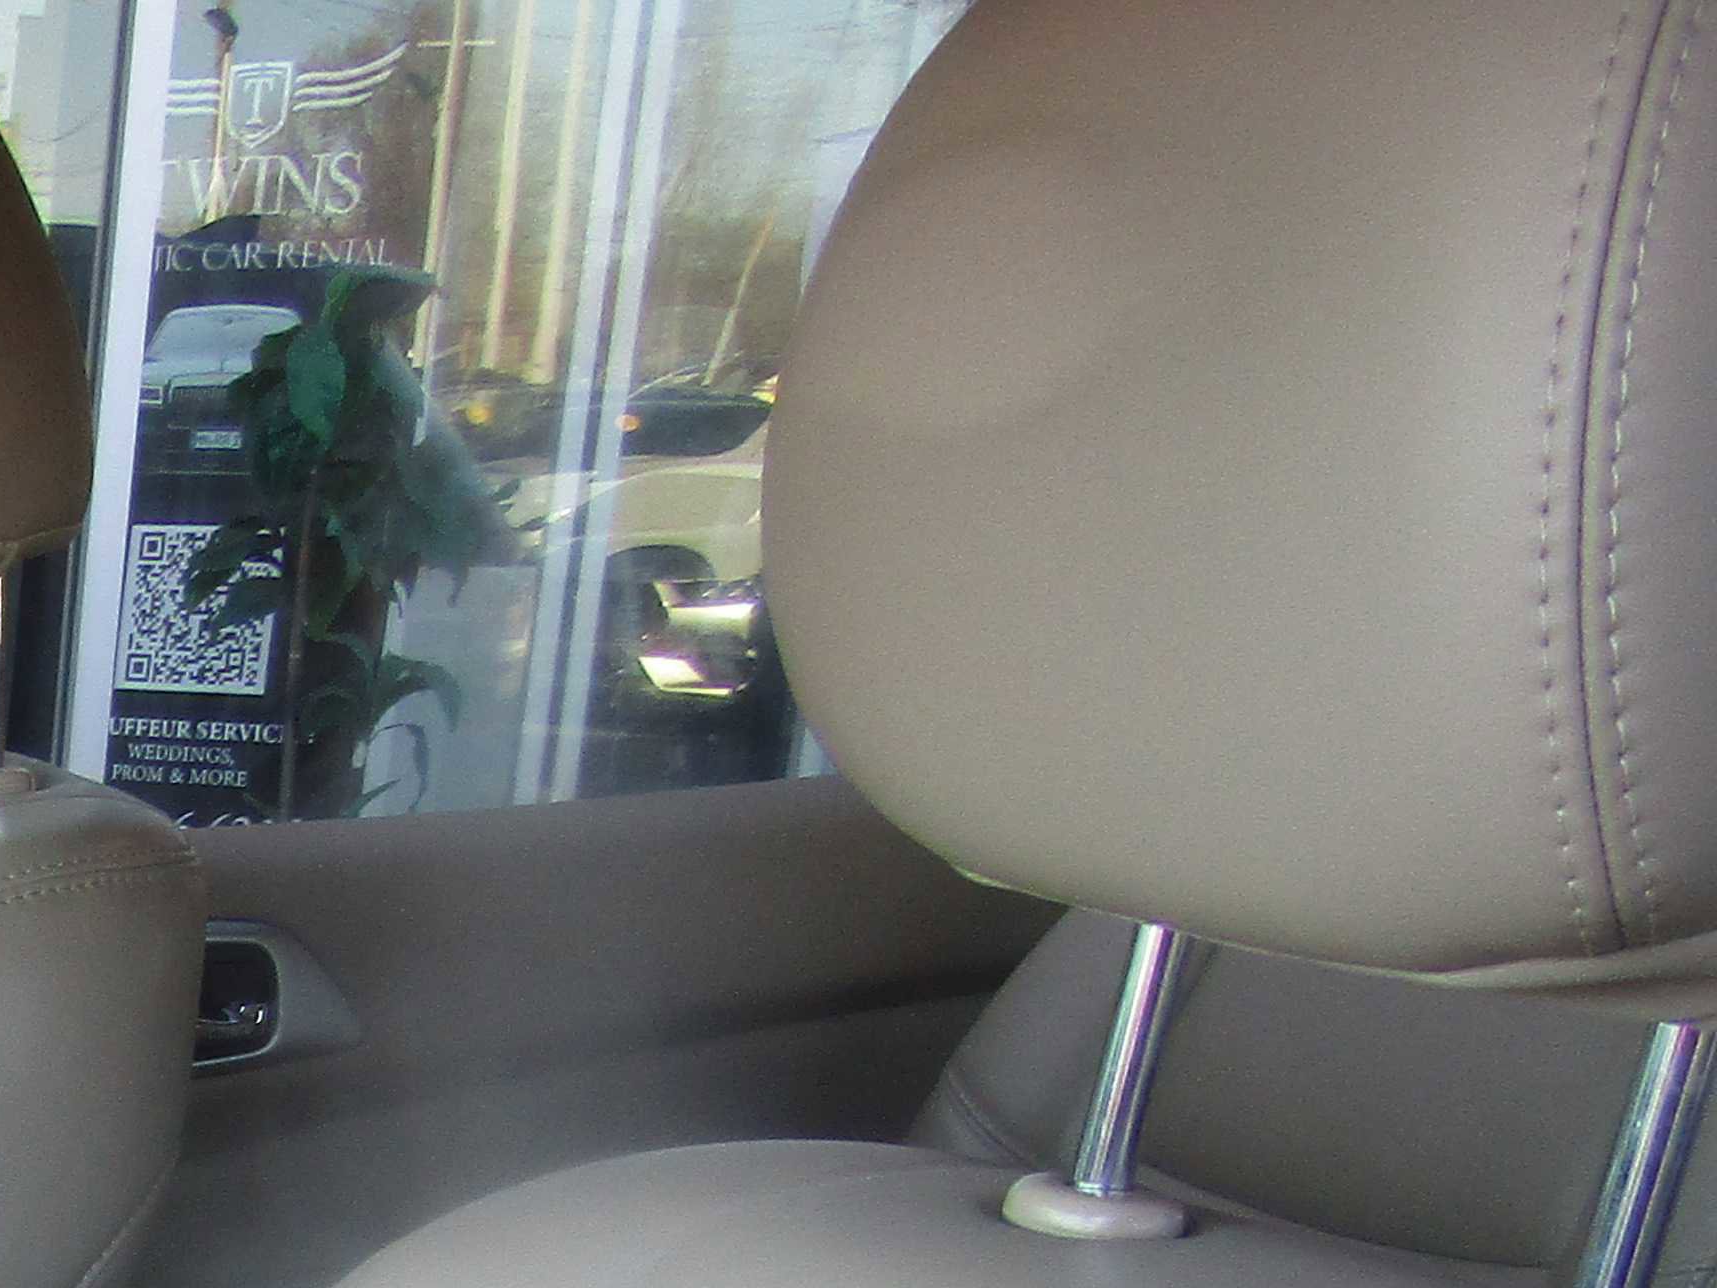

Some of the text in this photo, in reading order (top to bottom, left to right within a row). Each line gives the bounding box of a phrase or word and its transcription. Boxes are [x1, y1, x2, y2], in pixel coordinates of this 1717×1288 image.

[202, 243, 265, 271] CAR
[277, 237, 392, 269] RENTAL
[127, 743, 235, 766] WEDDINGS,
[112, 764, 248, 787] PROM & MORE
